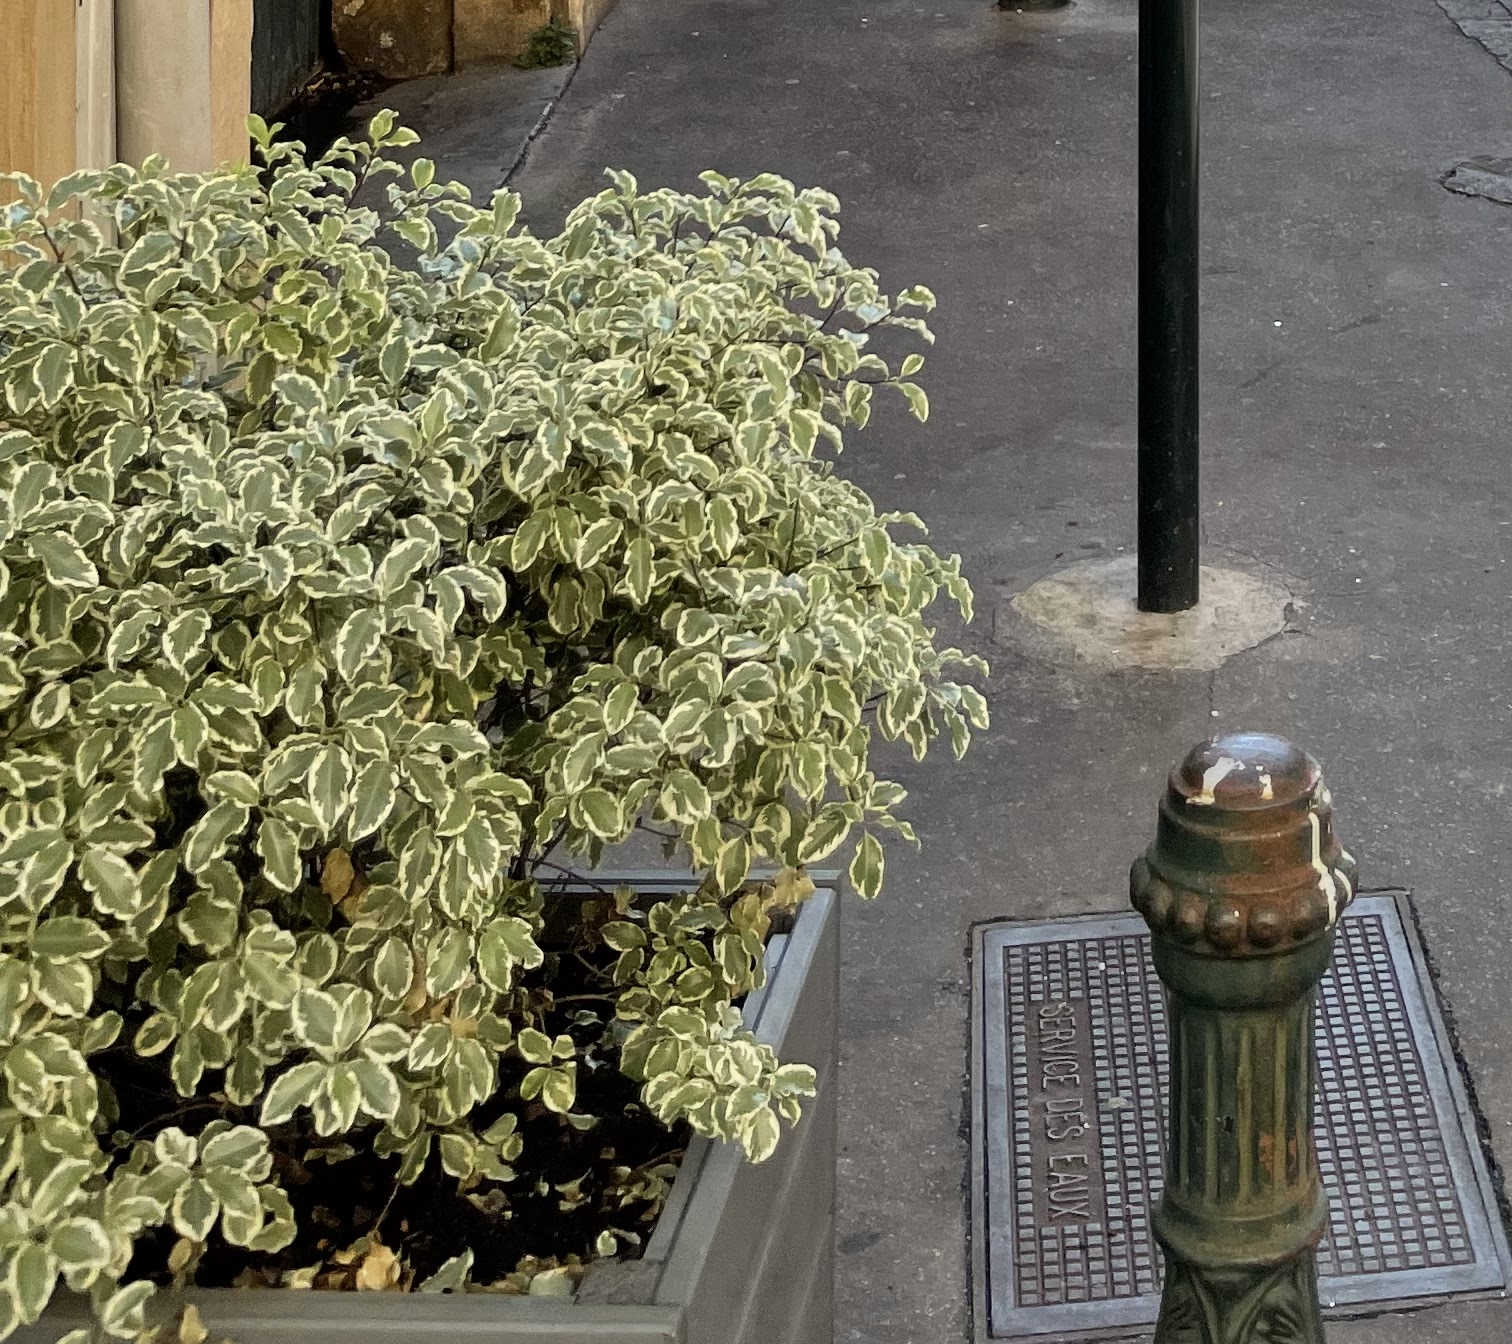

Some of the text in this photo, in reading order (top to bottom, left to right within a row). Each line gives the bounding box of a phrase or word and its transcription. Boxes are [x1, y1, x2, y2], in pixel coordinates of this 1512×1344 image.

[1039, 1001, 1090, 1220] SERVICE DES EAUX
